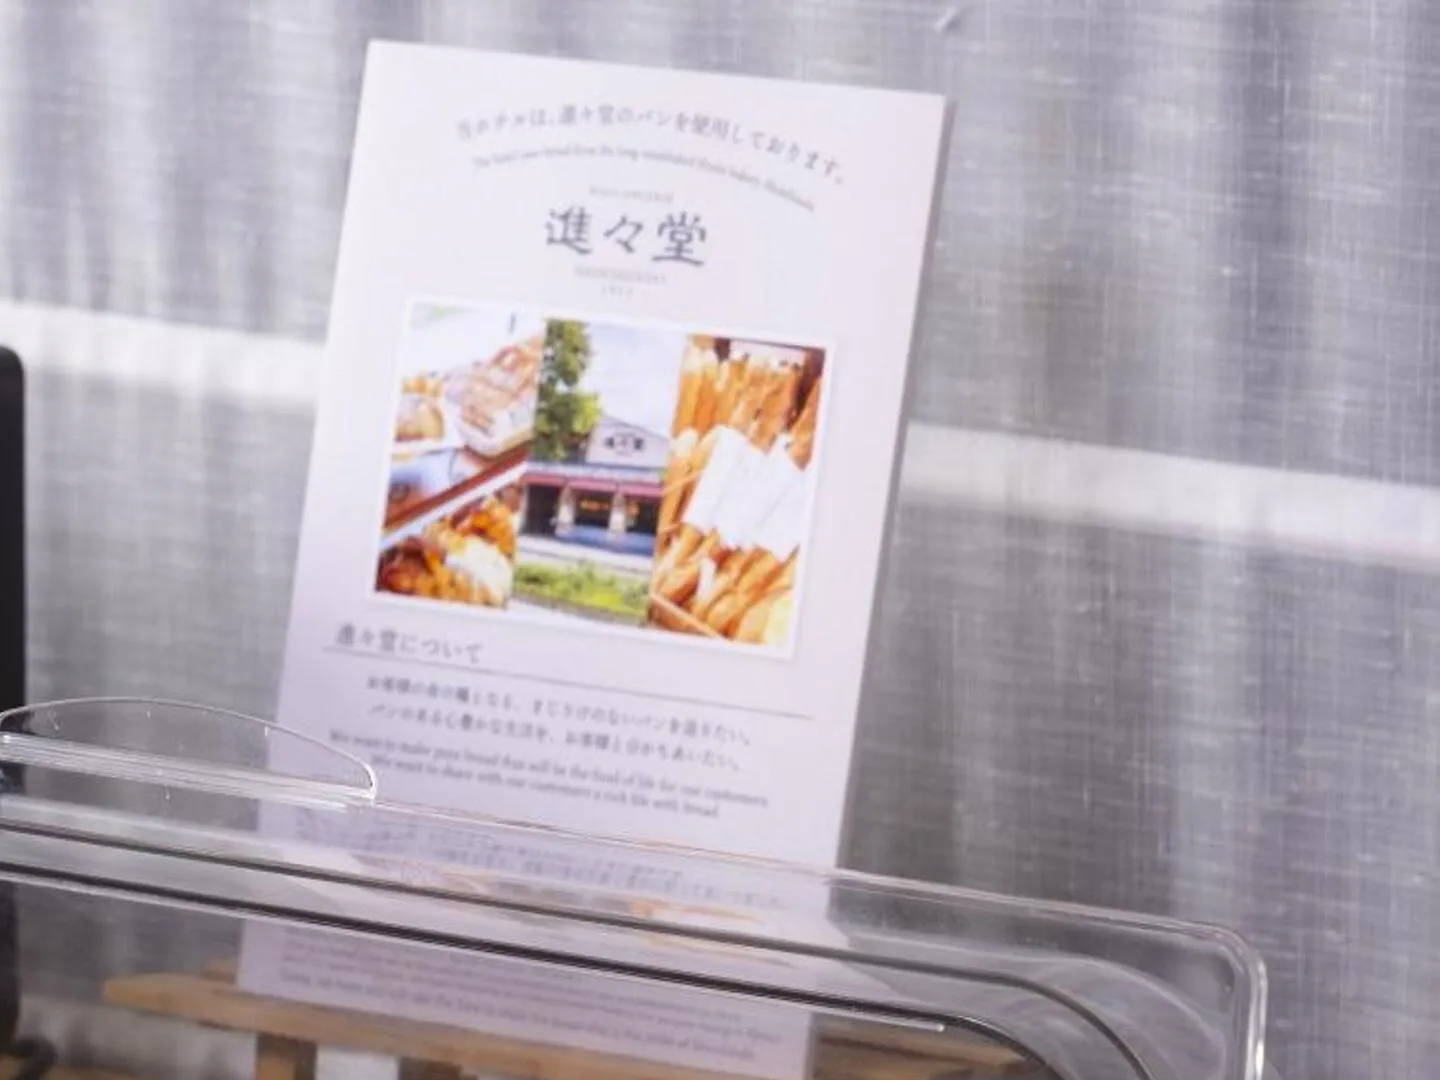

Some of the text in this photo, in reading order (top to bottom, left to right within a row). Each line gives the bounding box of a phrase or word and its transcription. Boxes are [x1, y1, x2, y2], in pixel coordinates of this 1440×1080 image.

[544, 206, 707, 267] 進々堂
[335, 622, 483, 664] 進々堂について
